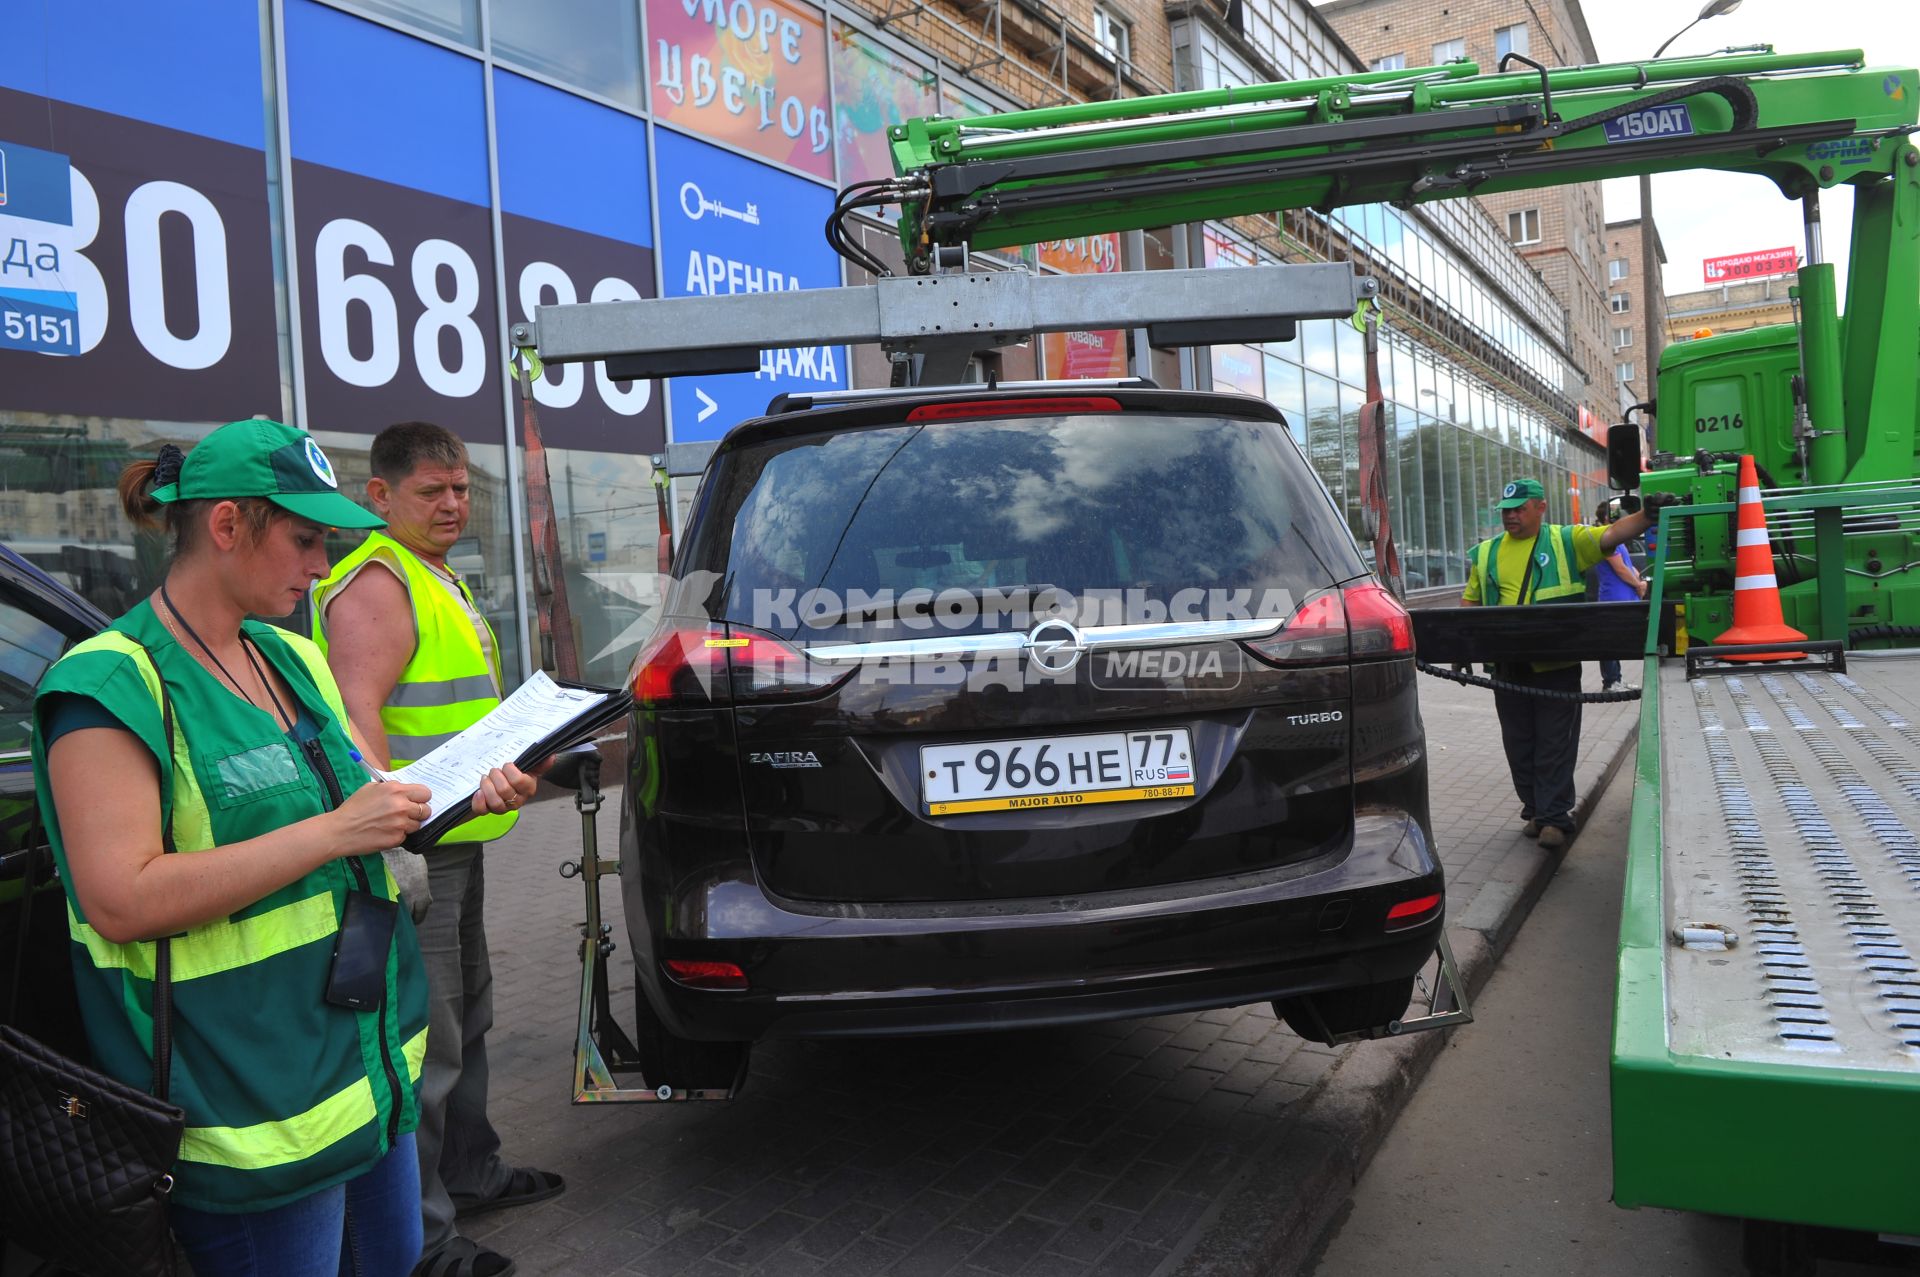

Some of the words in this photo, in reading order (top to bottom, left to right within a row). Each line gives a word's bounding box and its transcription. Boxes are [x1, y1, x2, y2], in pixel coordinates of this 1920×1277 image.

[656, 39, 831, 154] ЦВЕТОВ
[1753, 250, 1793, 262] МАГАЗИН
[315, 218, 486, 397] 68
[4, 311, 73, 346] 5151
[1696, 414, 1743, 433] 0216
[1287, 710, 1343, 726] TURBO
[750, 751, 819, 763] ZAFIRA
[1132, 734, 1173, 768] 77
[1135, 768, 1166, 782] RUS
[1009, 797, 1050, 808] MAJOR
[1053, 794, 1083, 805] AUTO
[1143, 786, 1186, 799] 780-88-77
